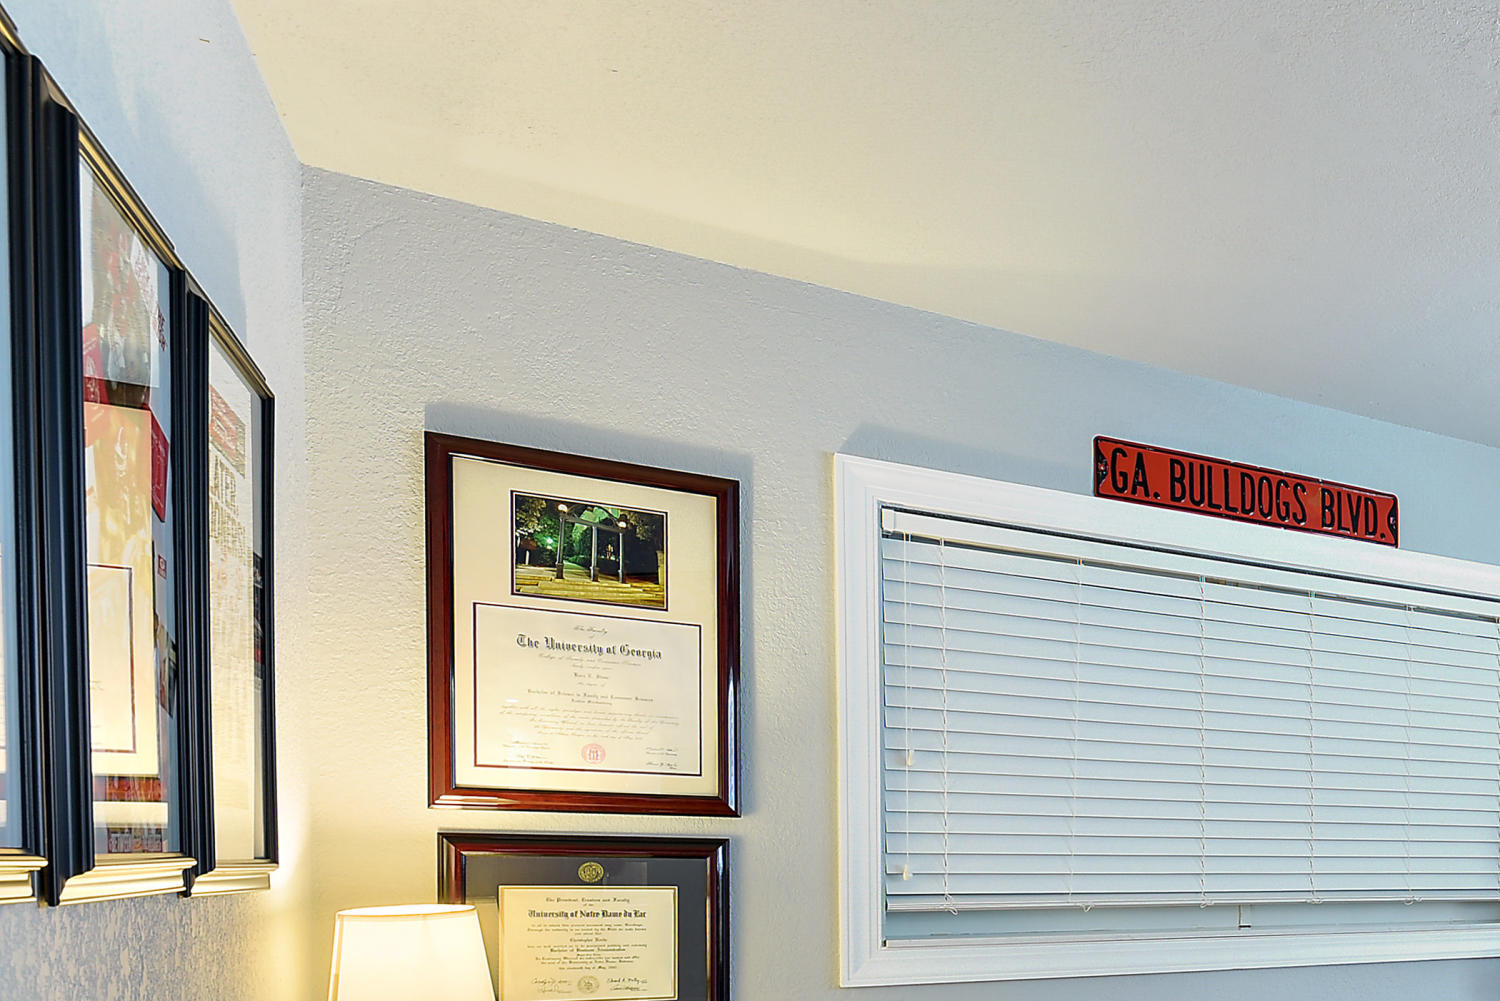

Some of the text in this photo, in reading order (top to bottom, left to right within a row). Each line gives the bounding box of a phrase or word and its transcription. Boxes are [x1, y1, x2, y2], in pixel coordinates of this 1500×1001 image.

[1110, 448, 1387, 540] GA. BULLDOGS BLVD.
[516, 633, 539, 649] The
[544, 636, 603, 657] University
[606, 645, 616, 655] of
[619, 644, 662, 660] Georgia
[528, 910, 646, 920] University of Notre Dame du Lac
